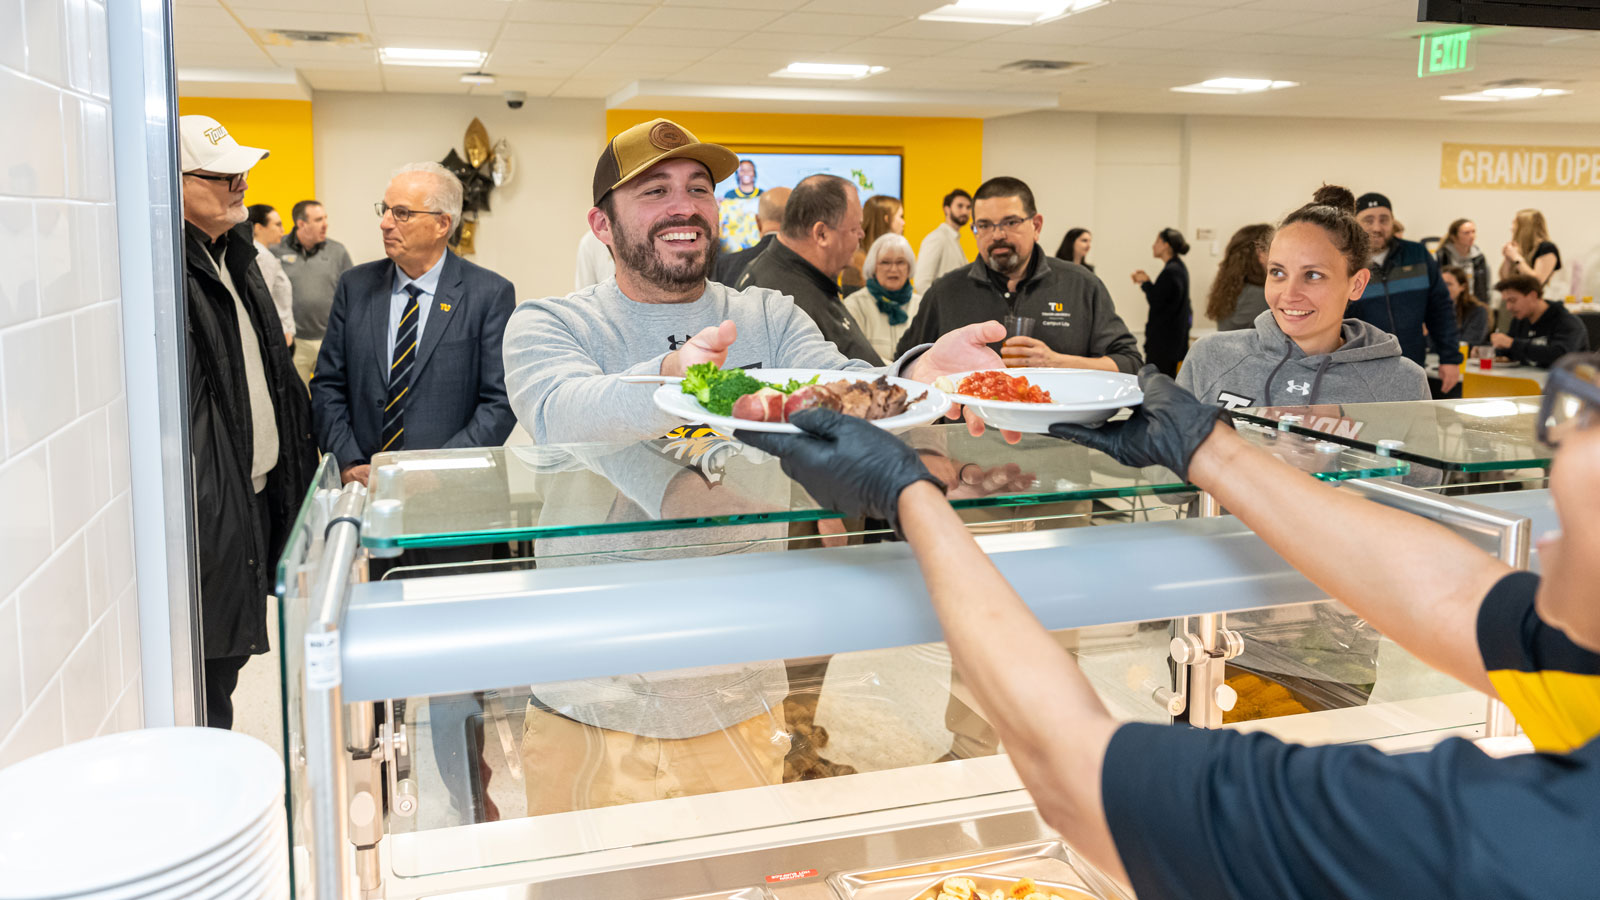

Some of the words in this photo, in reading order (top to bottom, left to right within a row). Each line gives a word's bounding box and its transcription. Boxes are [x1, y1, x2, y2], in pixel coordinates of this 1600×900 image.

[1429, 32, 1471, 72] EXIT
[1457, 149, 1549, 184] GRAND
[1555, 152, 1600, 185] OPE
[1048, 302, 1063, 311] TU
